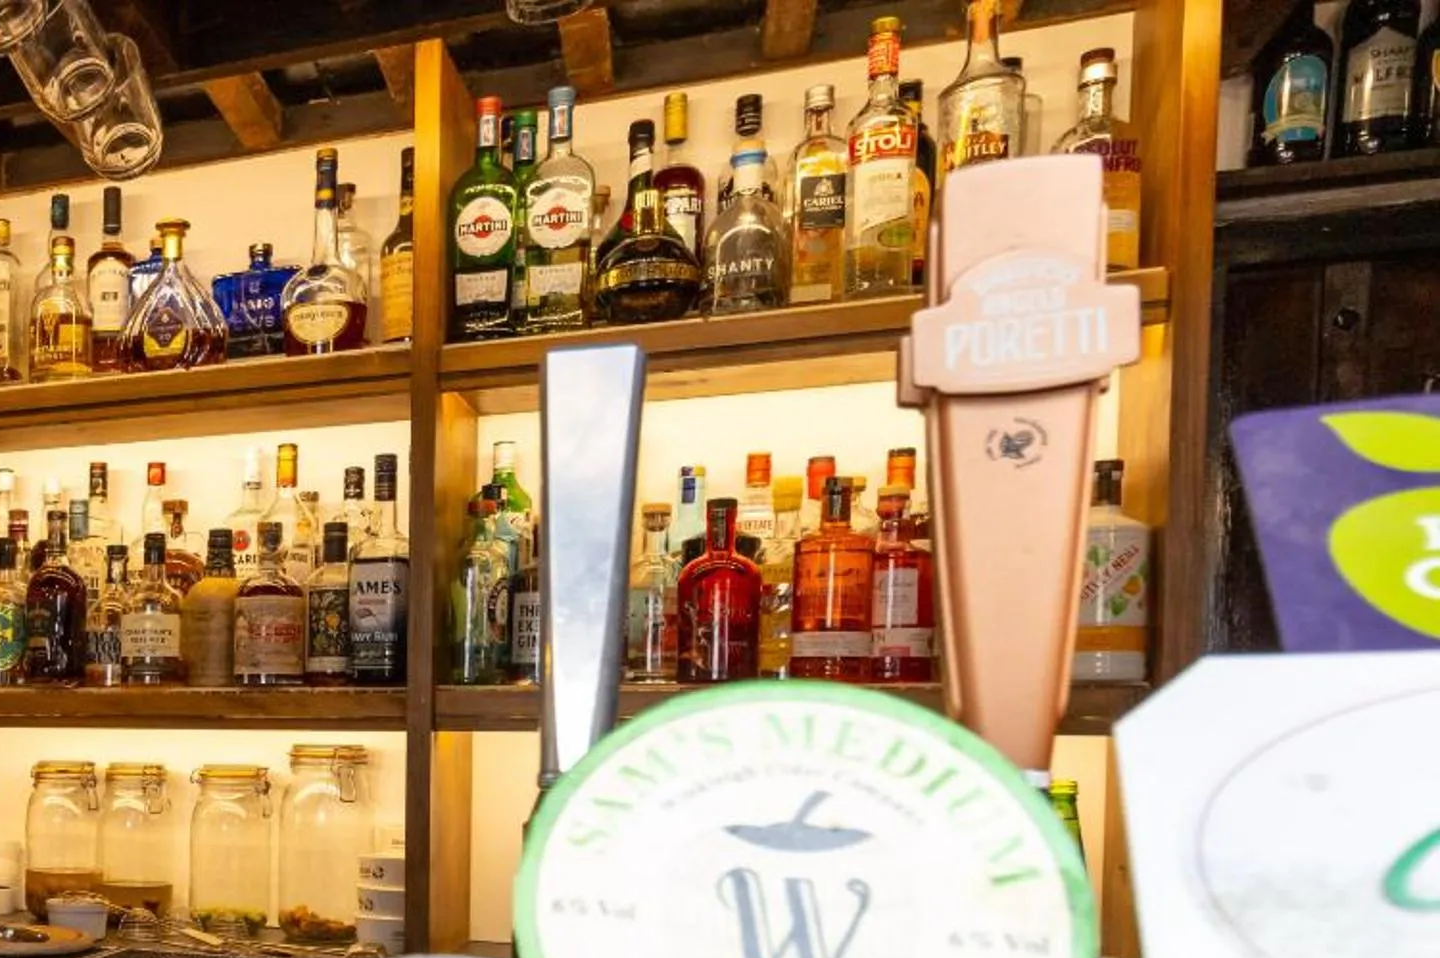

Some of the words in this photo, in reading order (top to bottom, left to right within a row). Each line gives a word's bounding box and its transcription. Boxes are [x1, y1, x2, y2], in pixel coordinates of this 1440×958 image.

[459, 220, 508, 236] MARTINI
[532, 211, 583, 227] MARTINI
[946, 306, 1108, 372] PORETTI
[567, 720, 736, 854] SAM'S
[766, 711, 1045, 889] MEDIUM
